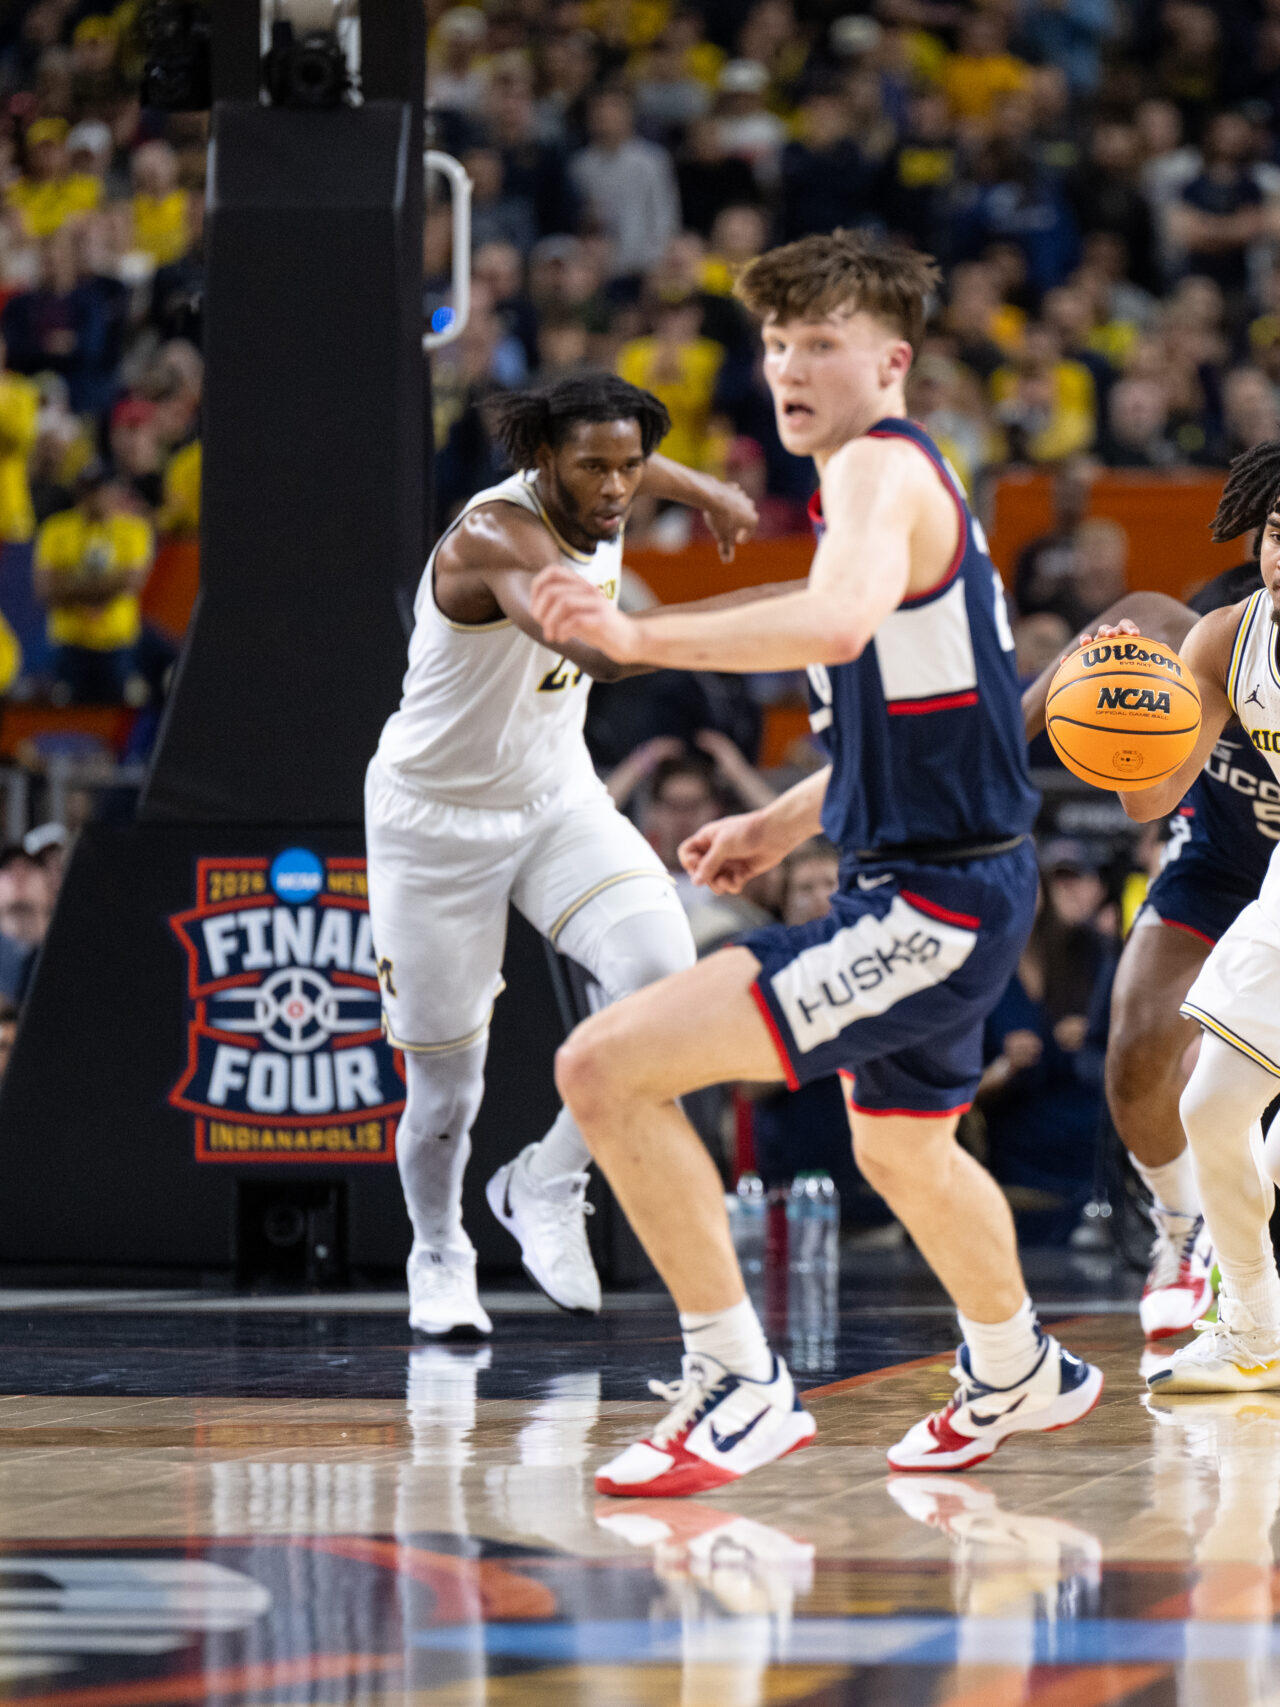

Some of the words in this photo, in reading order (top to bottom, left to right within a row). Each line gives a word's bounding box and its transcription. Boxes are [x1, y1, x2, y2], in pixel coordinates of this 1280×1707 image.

[1081, 643, 1182, 678] Wilson
[1096, 687, 1171, 714] NCAA
[207, 1044, 384, 1115] FOUR
[209, 1119, 382, 1151] INDIANAPOLIS
